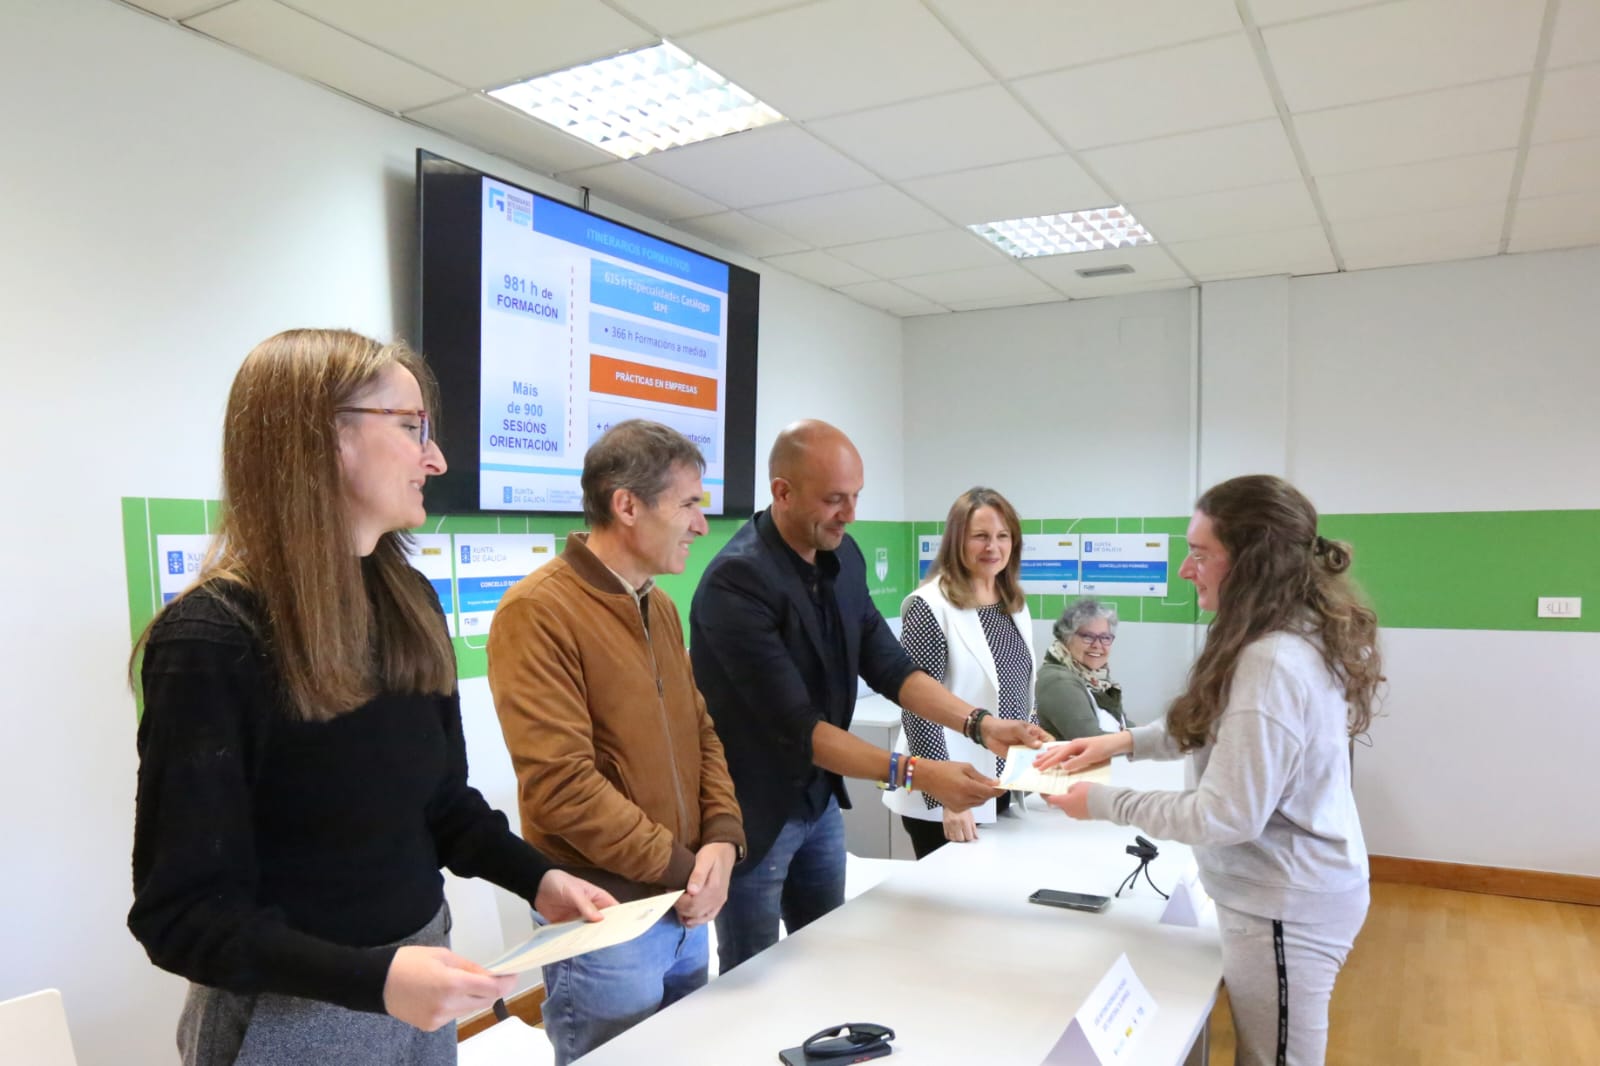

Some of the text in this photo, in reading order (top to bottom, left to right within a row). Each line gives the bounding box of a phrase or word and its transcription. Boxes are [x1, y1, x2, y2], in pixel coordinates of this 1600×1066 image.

[503, 274, 553, 300] 981 h de
[627, 278, 681, 304] Especialidades
[611, 326, 627, 340] 366
[682, 344, 707, 359] medida
[512, 380, 539, 397] Máis
[654, 378, 664, 388] EN
[664, 380, 698, 395] EMPRESAS
[507, 401, 543, 417] de 900
